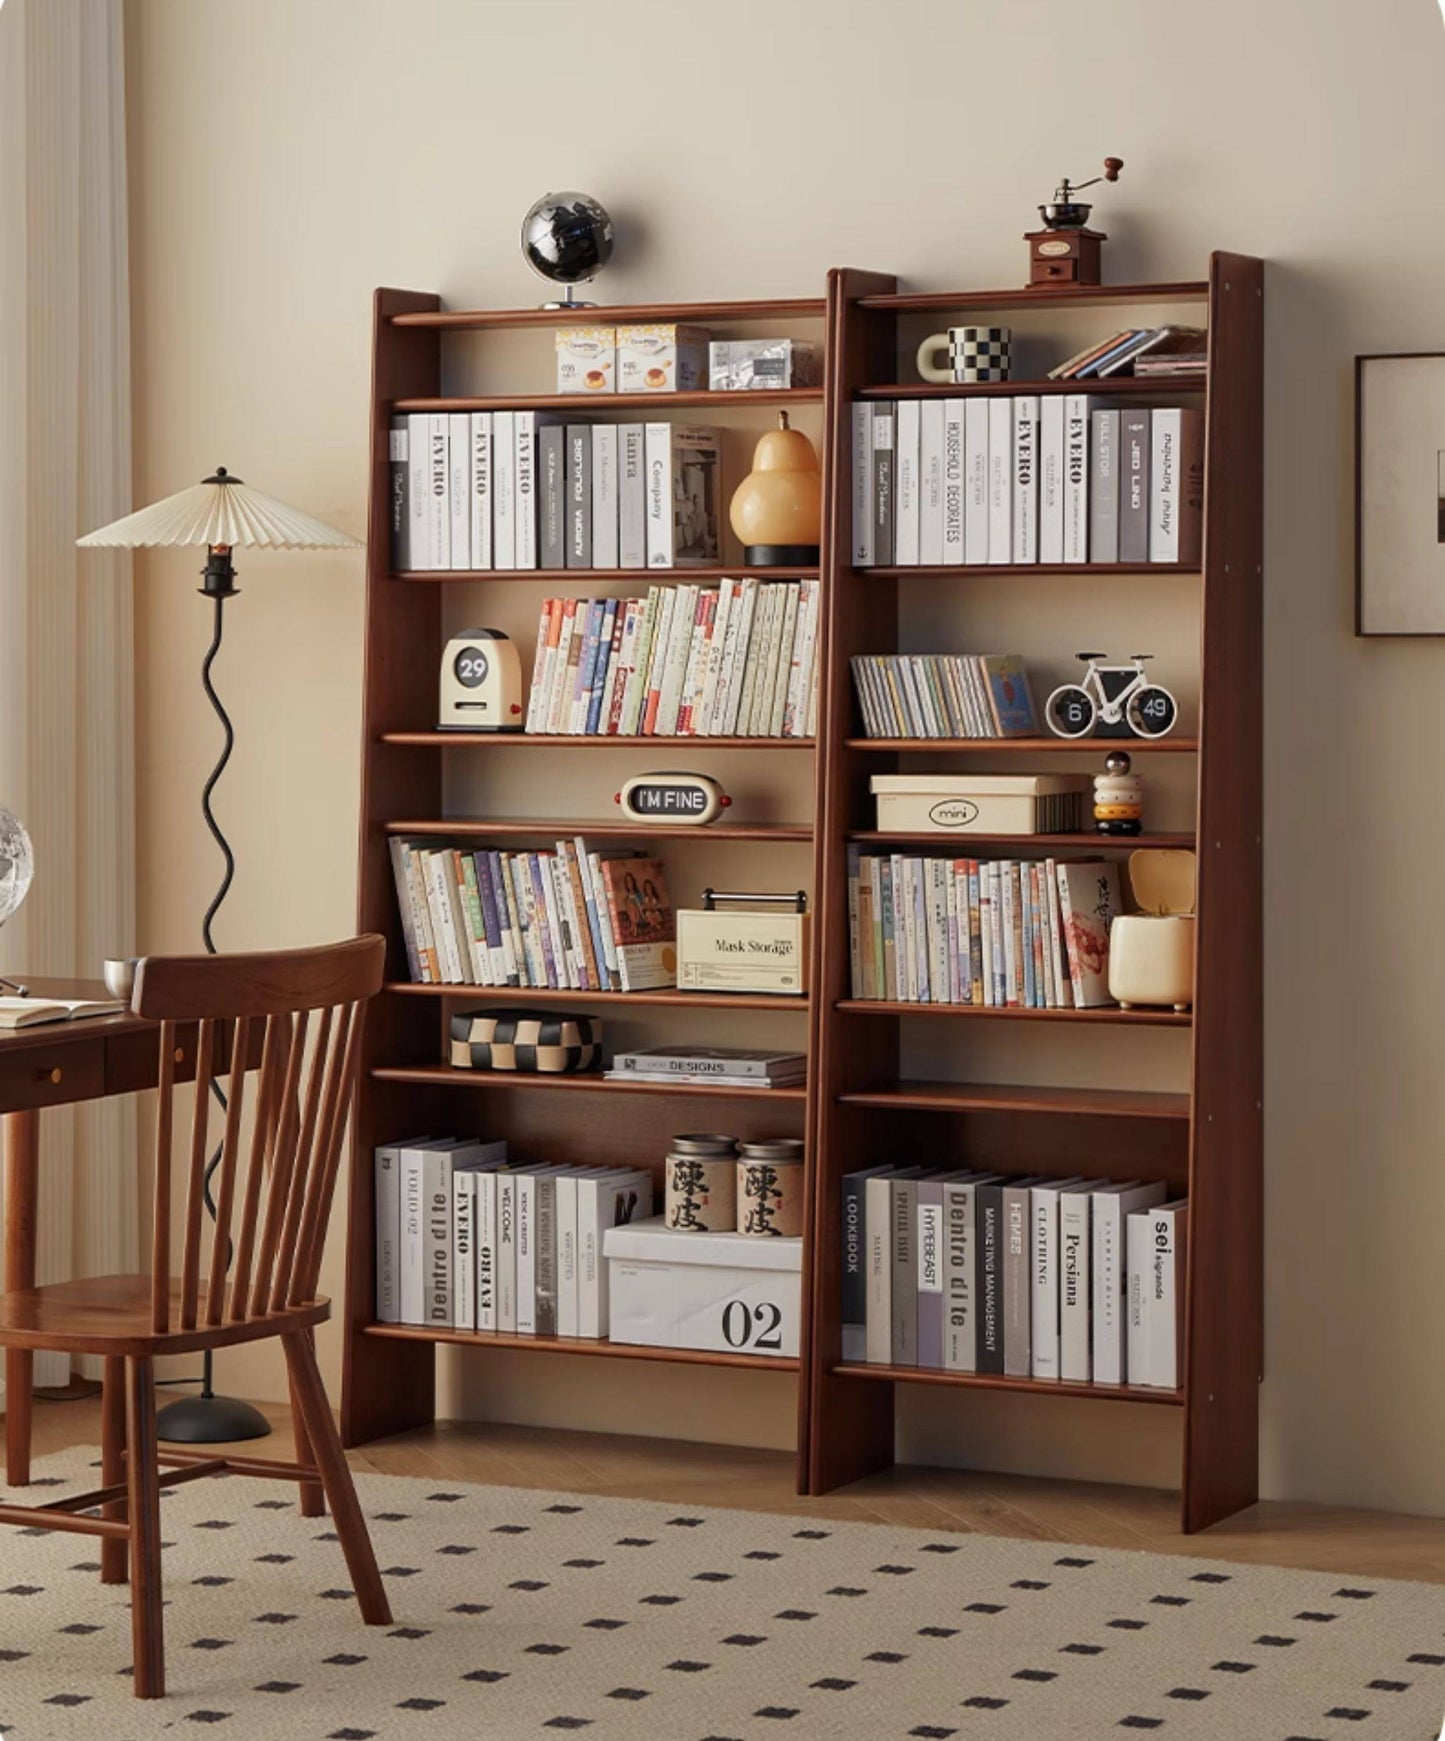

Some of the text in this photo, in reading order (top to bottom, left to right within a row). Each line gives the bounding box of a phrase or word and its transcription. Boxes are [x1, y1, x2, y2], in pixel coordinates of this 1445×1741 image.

[432, 434, 444, 496] EVERO
[476, 433, 487, 495] EVERO
[518, 432, 530, 495] EVERO
[946, 421, 960, 480] HOUSEHOLD
[1018, 420, 1031, 485] EVERO
[1070, 418, 1083, 484] EVERO
[1131, 440, 1141, 470] JED
[652, 460, 664, 520] Company
[460, 659, 486, 678] 29
[1069, 698, 1166, 722] 6 49
[638, 790, 704, 809] I'M FINE
[939, 806, 967, 819] mini
[715, 939, 793, 956] Mask Storage
[669, 1060, 725, 1073] DESIGNS
[457, 1192, 469, 1254] EVERO
[502, 1186, 512, 1244] WELCOME
[671, 1160, 709, 1232] 陳皮
[744, 1165, 783, 1236] 陳皮
[847, 1194, 858, 1273] LOOKBOOK
[923, 1208, 936, 1286] HYPEBEAST
[950, 1192, 968, 1267] Dentro
[1010, 1202, 1022, 1255] HOMES
[1038, 1207, 1047, 1285] CLOTHING
[1155, 1221, 1173, 1254] sei
[430, 1249, 448, 1321] Dentro
[480, 1246, 492, 1309] EVERO
[985, 1207, 996, 1352] MARKETING MANAGEMENT
[1065, 1233, 1080, 1306] Persiana
[721, 1300, 782, 1349] 02
